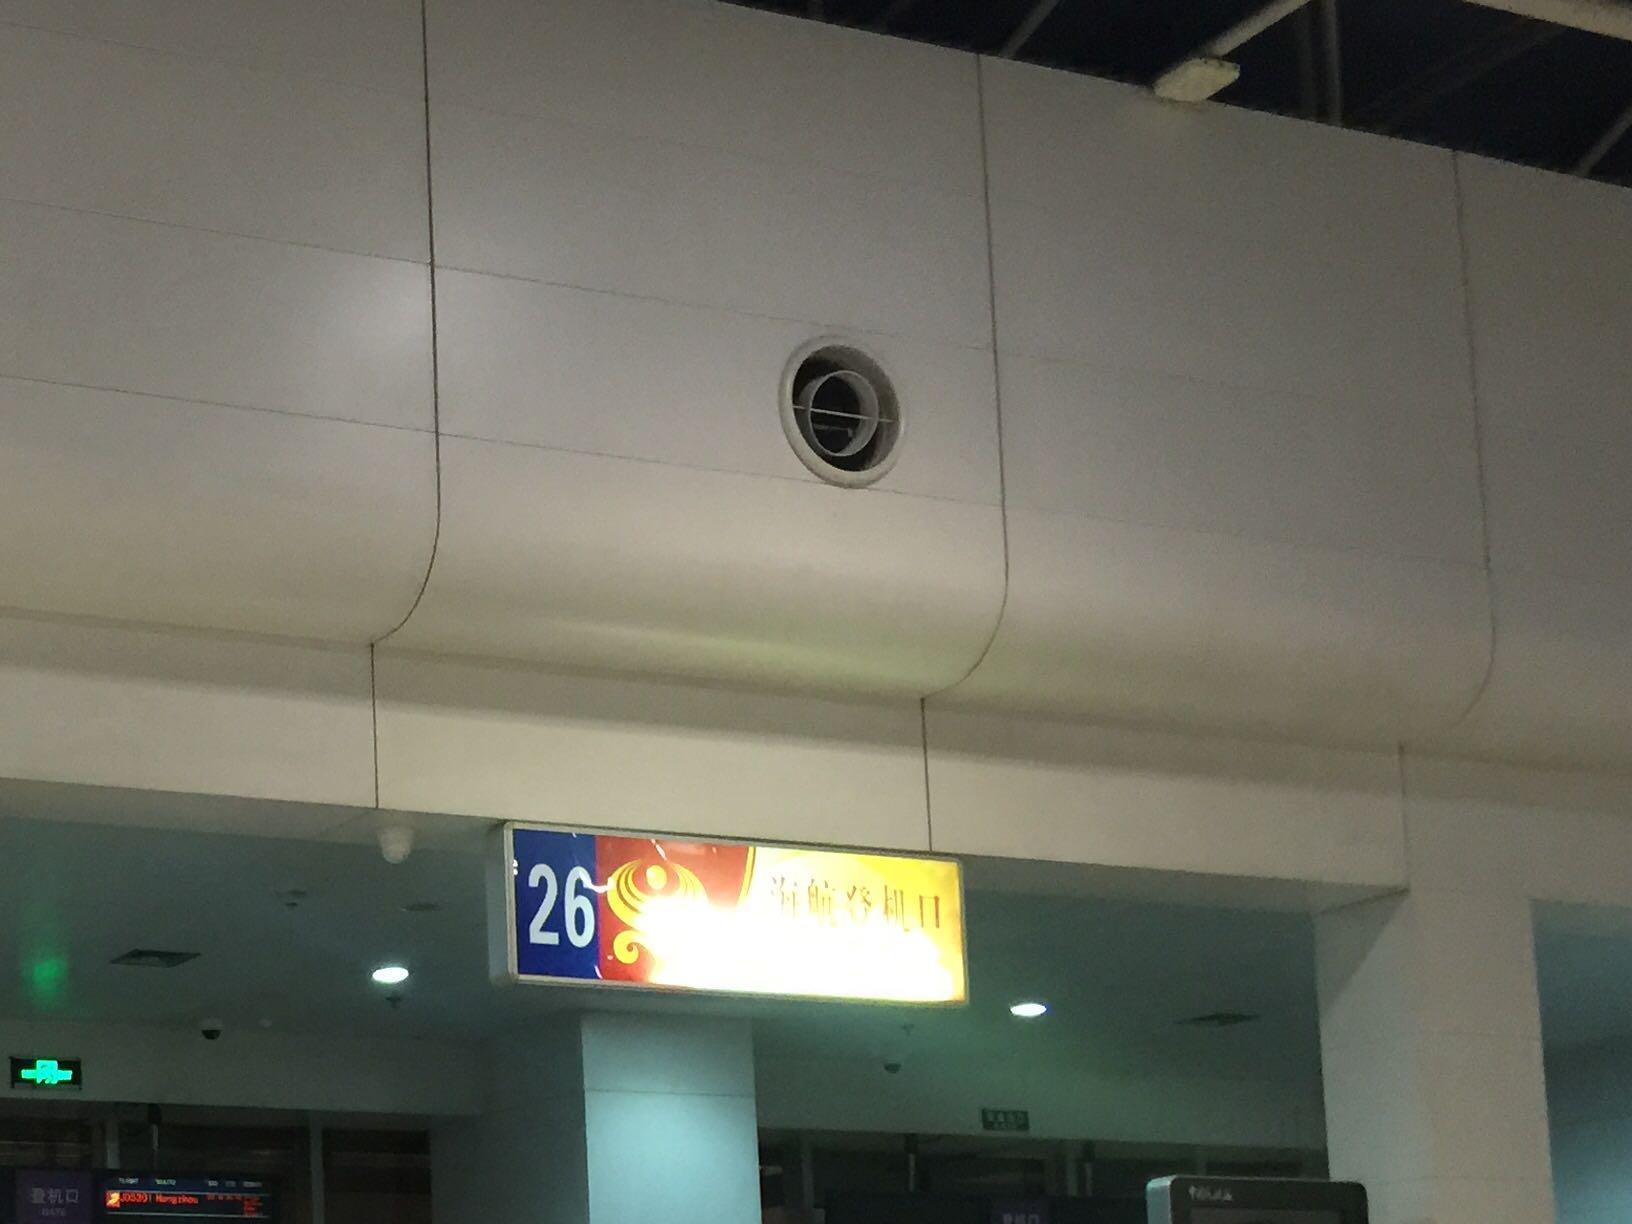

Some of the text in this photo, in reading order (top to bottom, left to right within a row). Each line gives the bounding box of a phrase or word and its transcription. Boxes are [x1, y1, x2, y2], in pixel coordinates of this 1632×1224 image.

[527, 863, 596, 948] 26
[29, 1187, 79, 1204] 登机口
